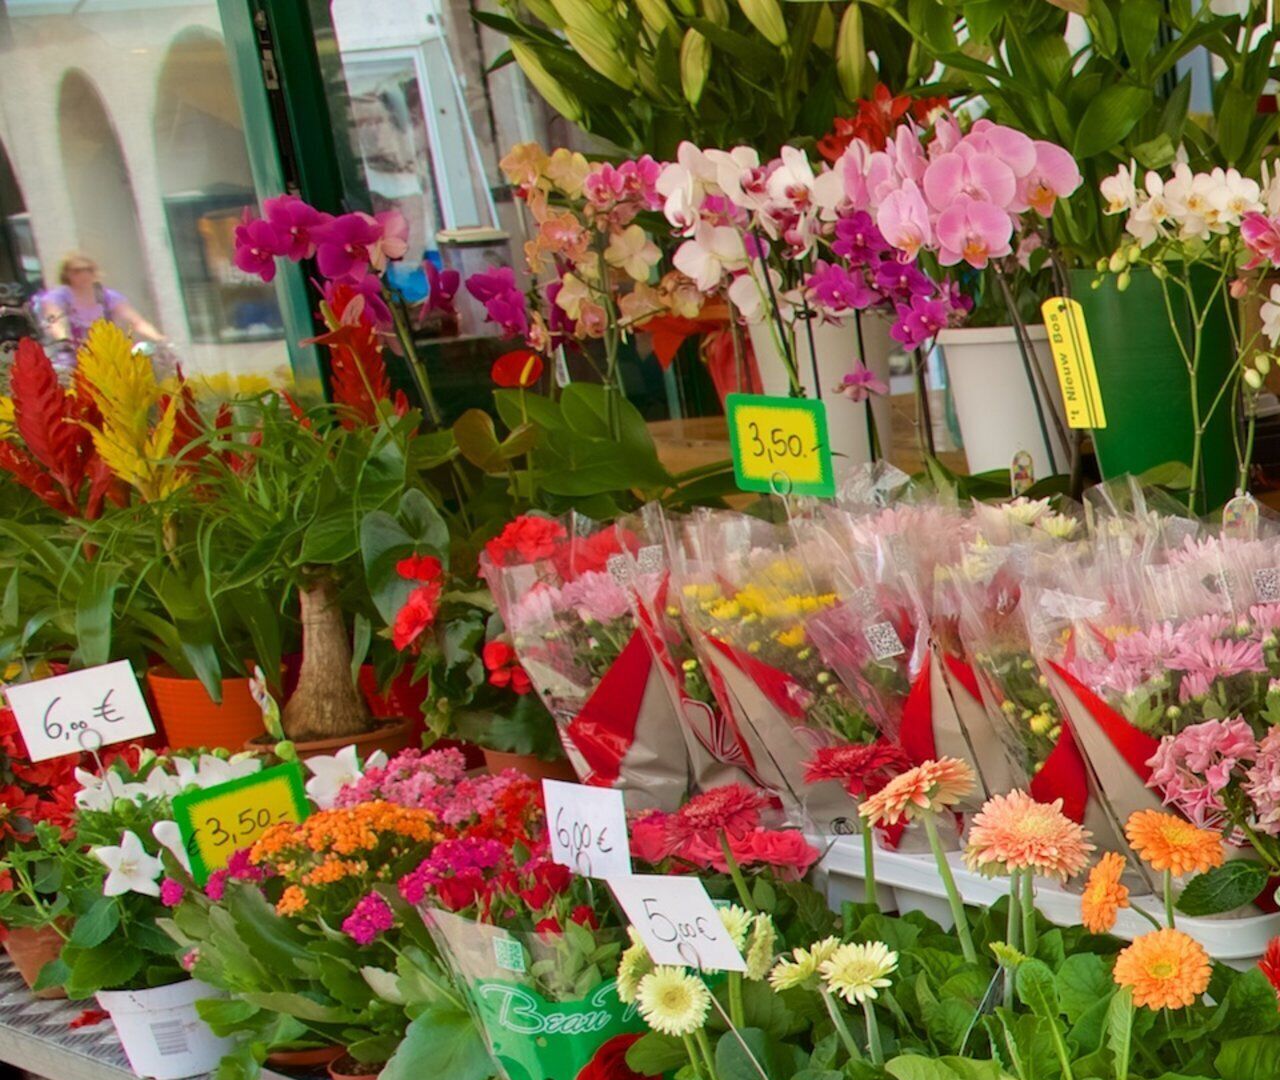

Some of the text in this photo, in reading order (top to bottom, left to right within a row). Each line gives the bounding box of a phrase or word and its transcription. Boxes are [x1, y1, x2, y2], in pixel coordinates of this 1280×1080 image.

[1049, 313, 1064, 344] Bos
[1060, 352, 1077, 401] Nieuw
[92, 688, 125, 724] €
[478, 983, 612, 1035] Beau
